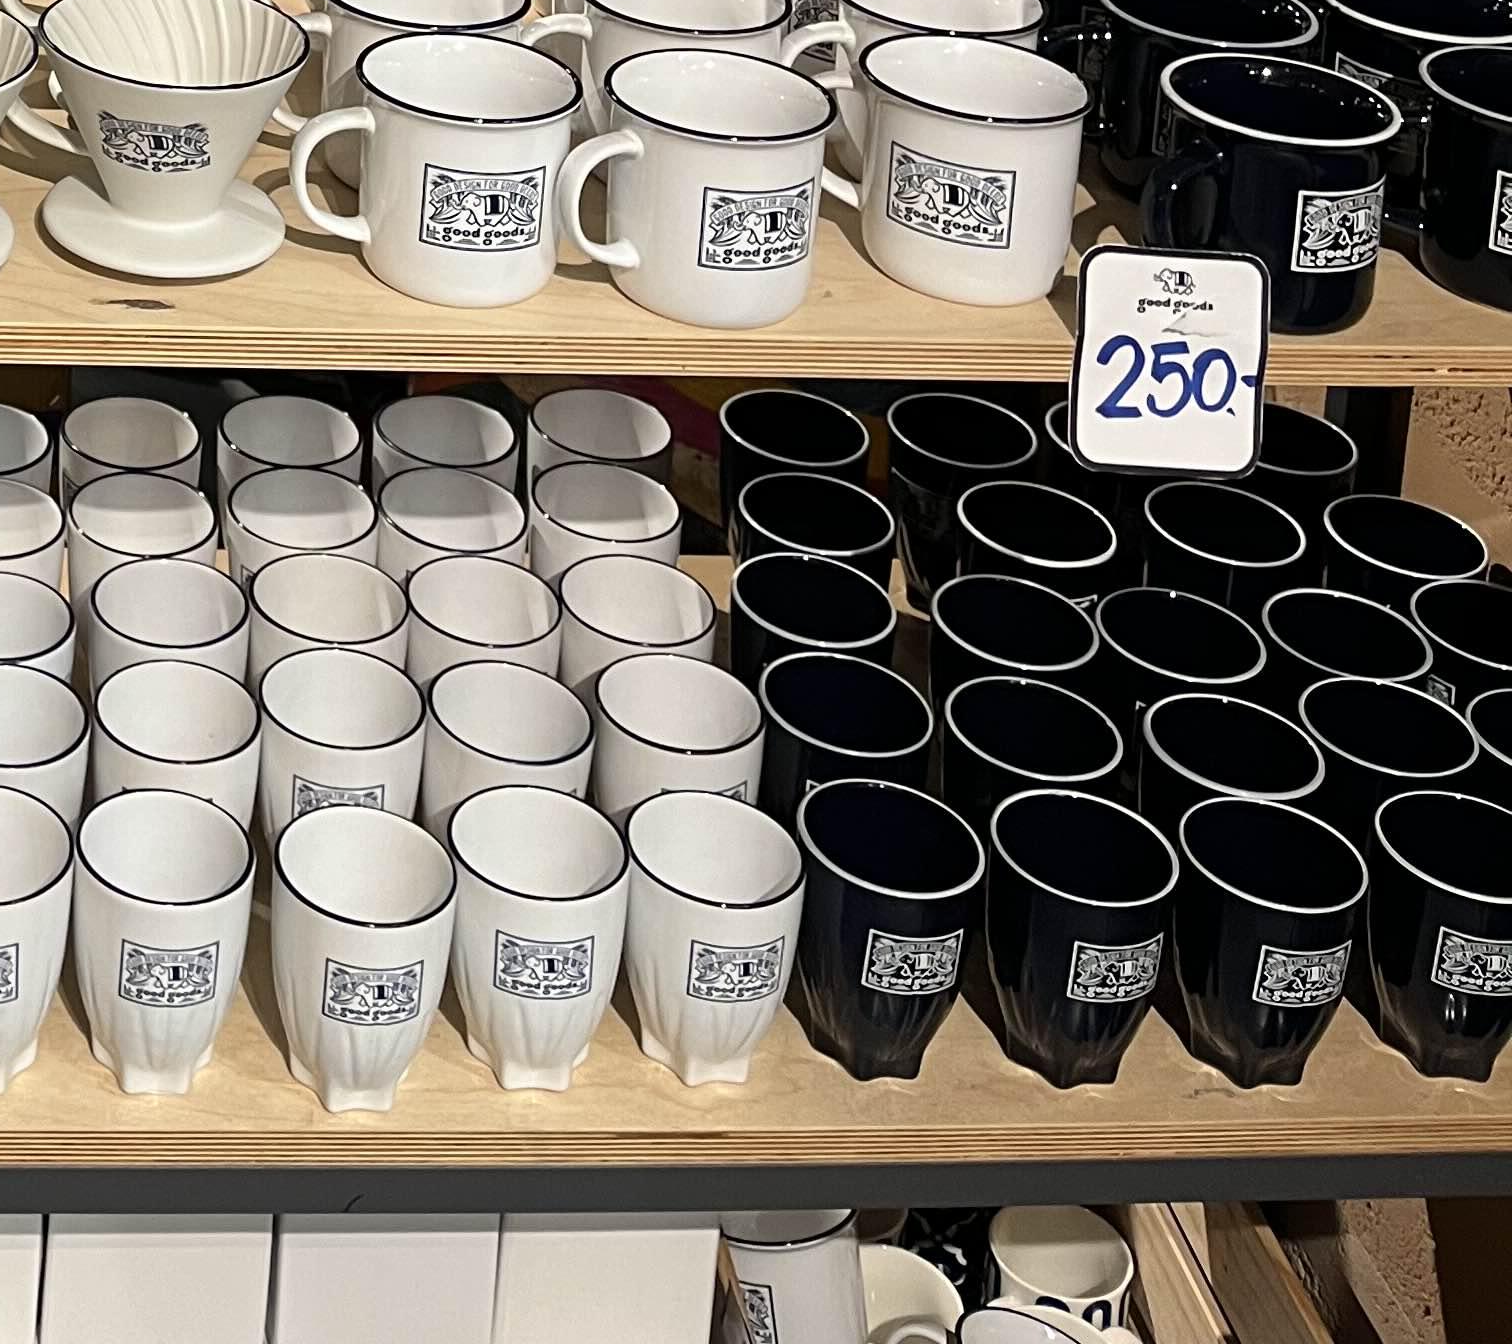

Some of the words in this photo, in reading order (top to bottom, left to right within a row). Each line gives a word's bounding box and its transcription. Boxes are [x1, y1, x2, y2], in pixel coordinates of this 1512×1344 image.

[904, 206, 938, 222] good
[942, 218, 988, 235] goods
[442, 226, 480, 242] good
[483, 226, 525, 246] goods
[722, 246, 760, 264] good
[763, 242, 798, 264] goods
[1316, 245, 1351, 266] good
[1137, 297, 1171, 314] good
